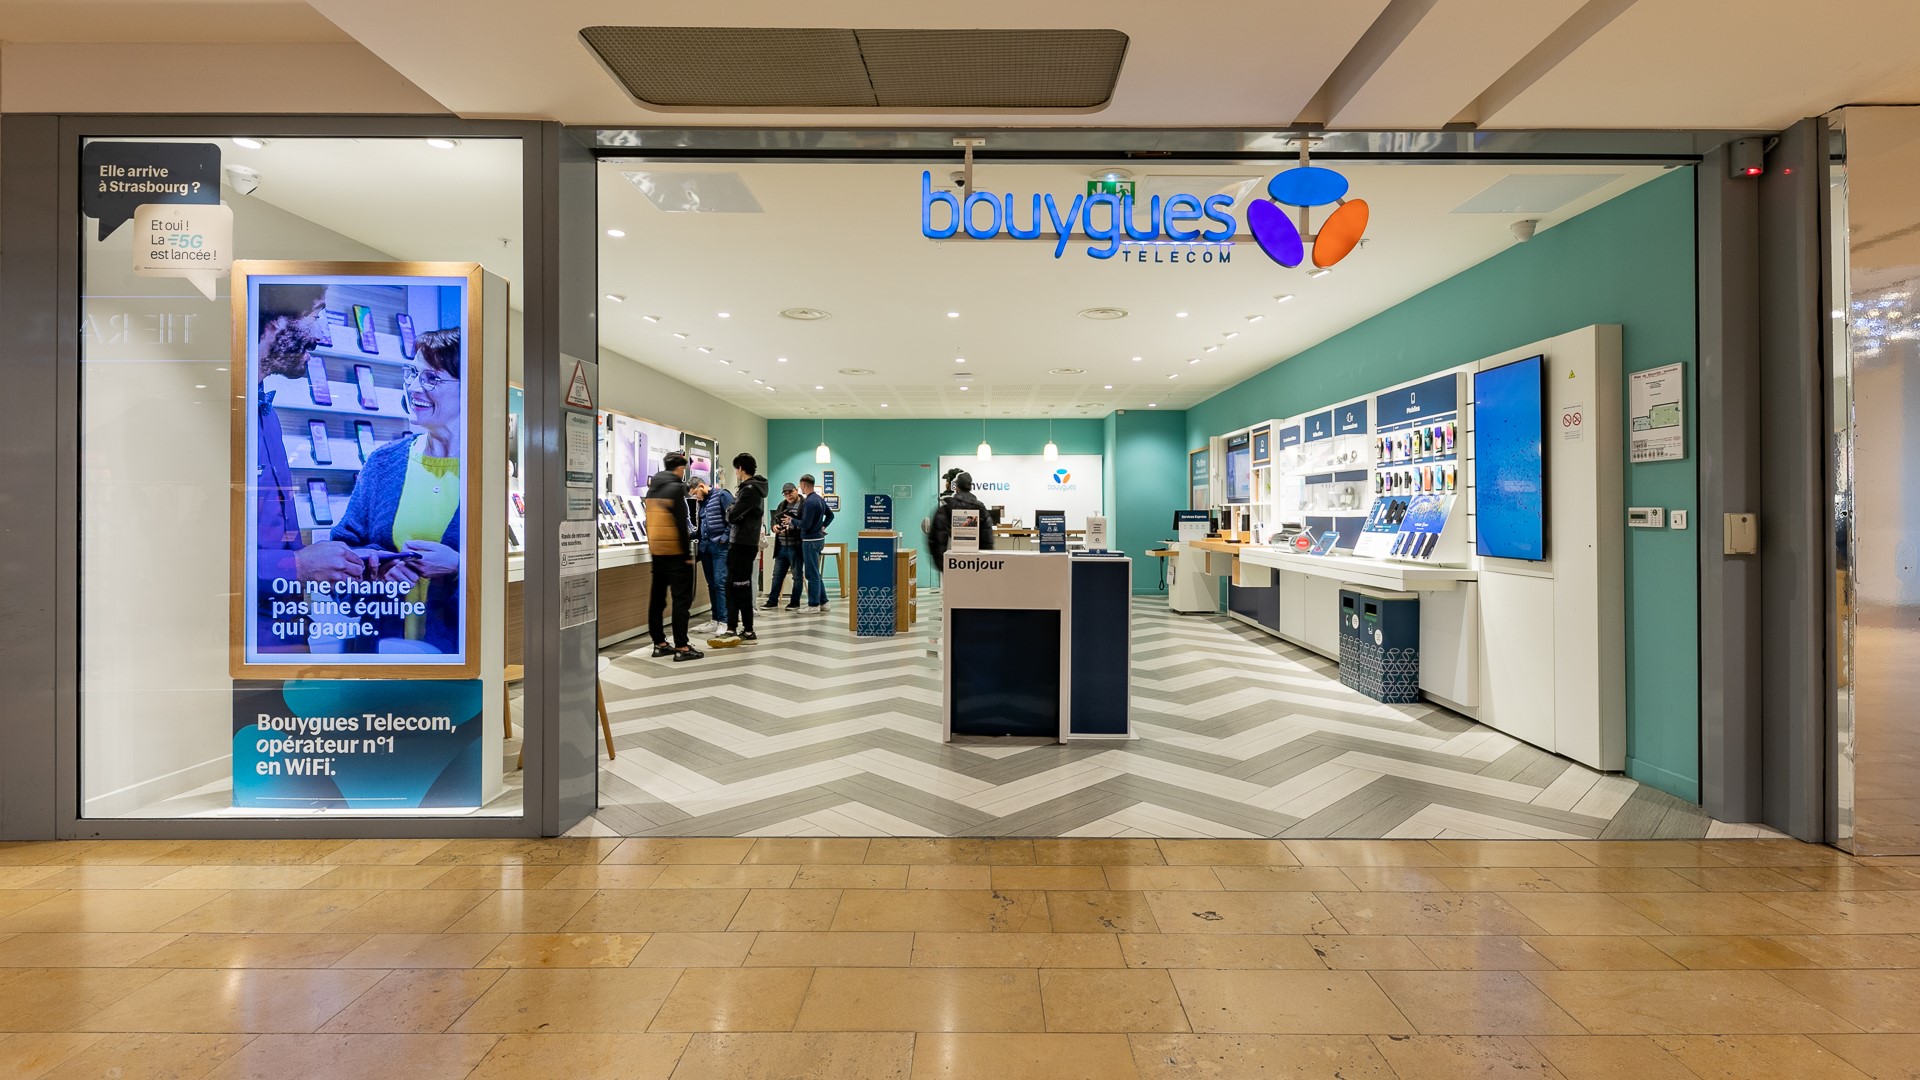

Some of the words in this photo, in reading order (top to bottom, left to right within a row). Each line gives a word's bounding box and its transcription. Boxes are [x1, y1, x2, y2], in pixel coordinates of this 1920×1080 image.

[100, 165, 125, 177] Elle
[128, 165, 169, 177] arrive
[99, 180, 107, 192] à
[109, 181, 189, 196] Strasbourg
[191, 181, 201, 194] ?
[922, 170, 1237, 259] bouygues
[151, 219, 163, 231] Et
[165, 219, 183, 231] oui
[151, 234, 165, 246] La
[178, 234, 203, 249] 5G
[150, 250, 169, 260] est
[171, 249, 211, 261] lancée
[1122, 250, 1231, 263] TELECOM
[948, 558, 1004, 572] Bonjour
[272, 577, 301, 594] On
[306, 580, 331, 594] ne
[334, 577, 411, 598] change
[272, 601, 309, 619] pas
[312, 601, 350, 615] une
[354, 598, 426, 619] équipe
[272, 618, 304, 640] qui
[308, 621, 379, 640] gagne.
[257, 713, 359, 735] Bouygues
[362, 713, 457, 734] Telecom,
[256, 735, 359, 757] opérateur
[363, 735, 394, 754] n°1
[256, 760, 281, 776] en
